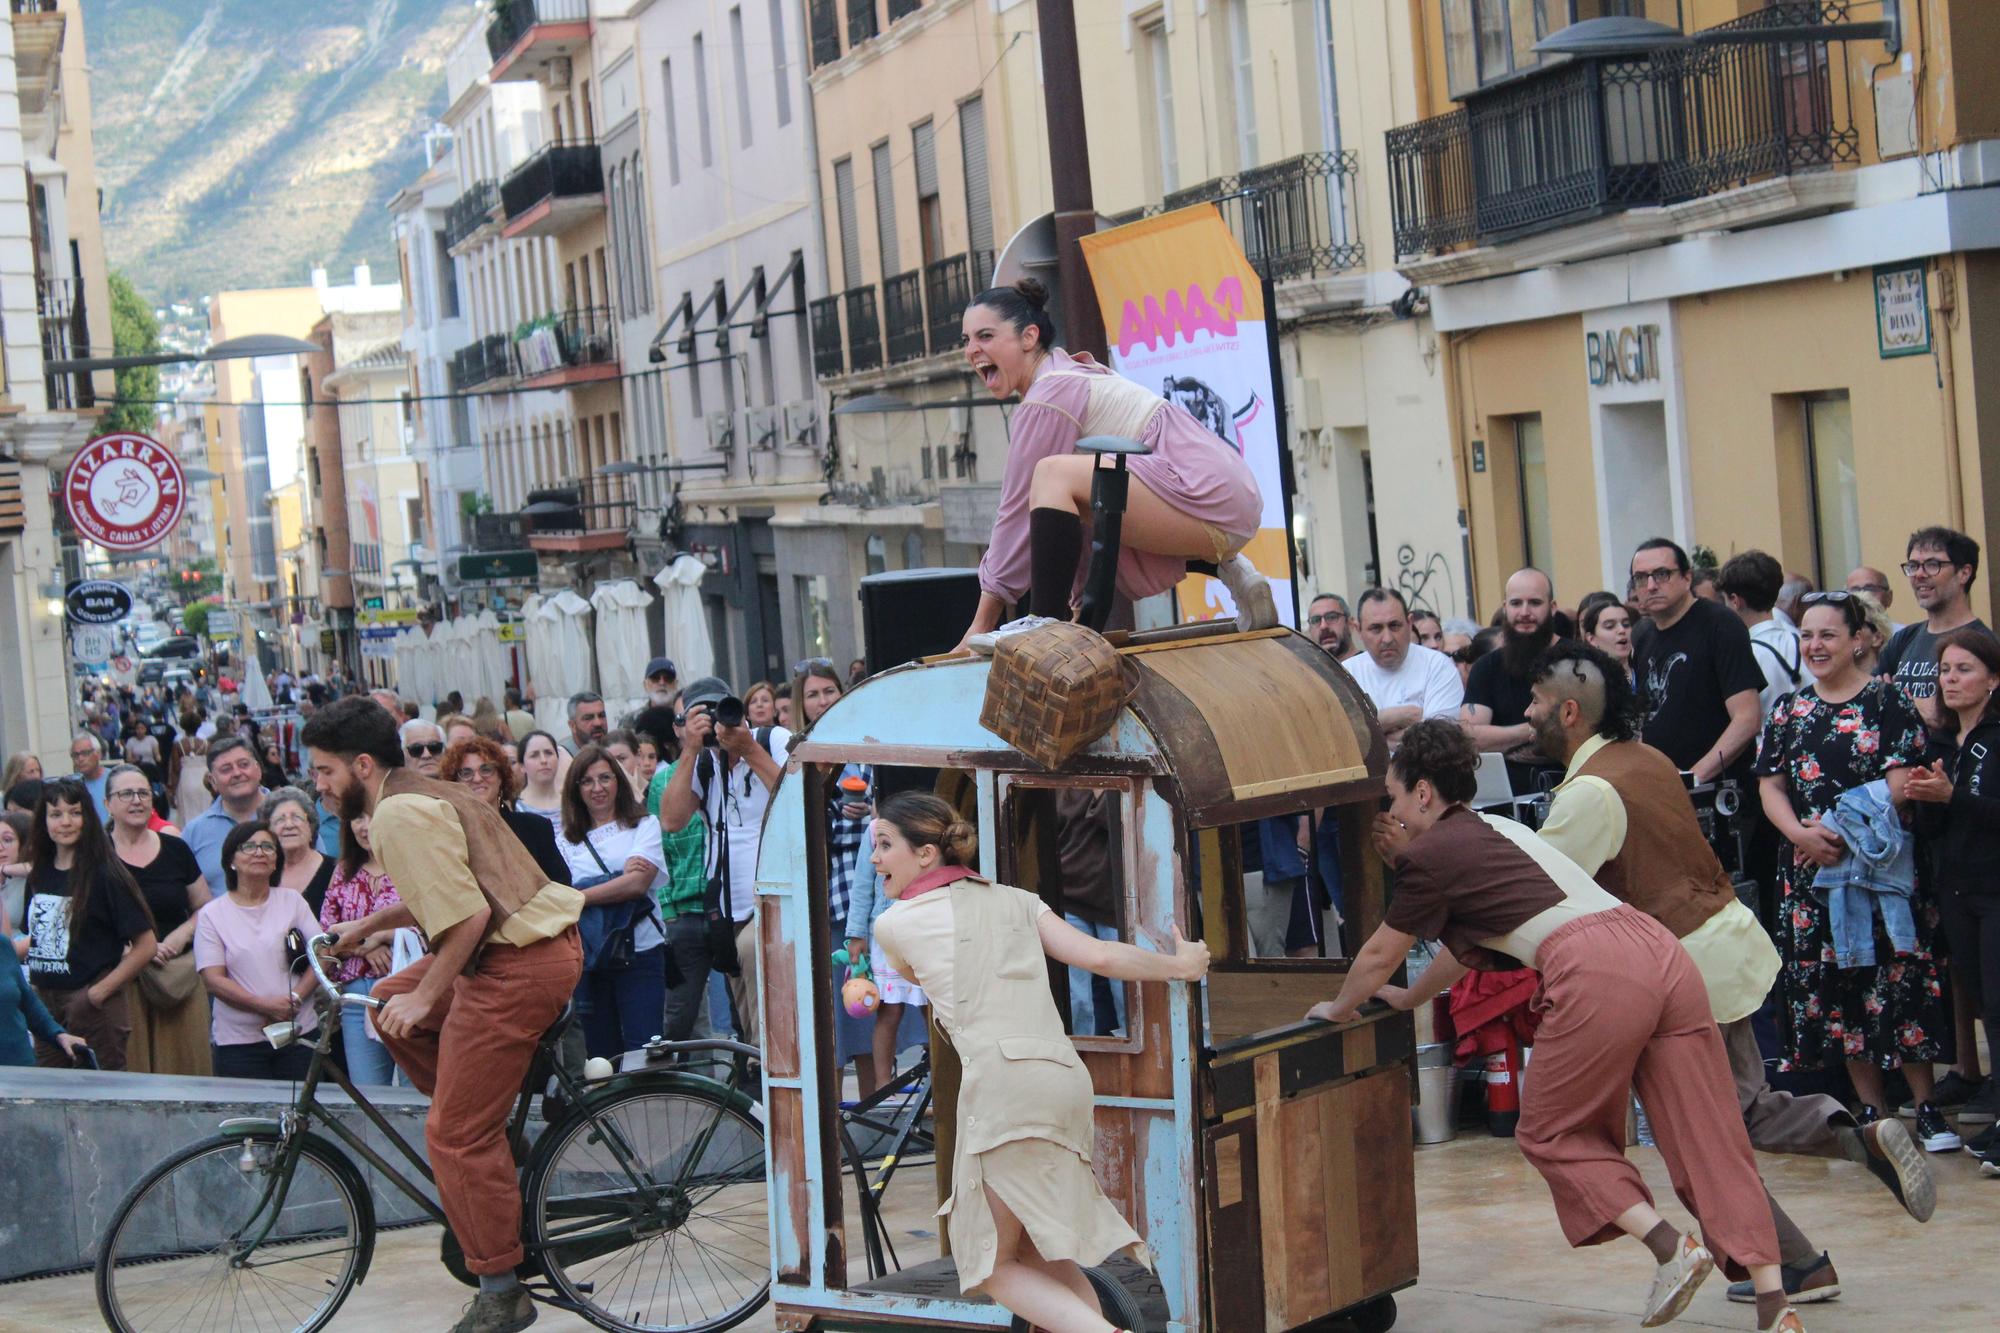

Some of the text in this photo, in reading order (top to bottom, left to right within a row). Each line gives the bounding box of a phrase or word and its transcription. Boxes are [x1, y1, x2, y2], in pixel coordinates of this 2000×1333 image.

[1890, 312, 1916, 330] DIANA
[73, 440, 177, 495] LIZARRAN
[142, 527, 149, 538] Y
[85, 597, 114, 607] BAR
